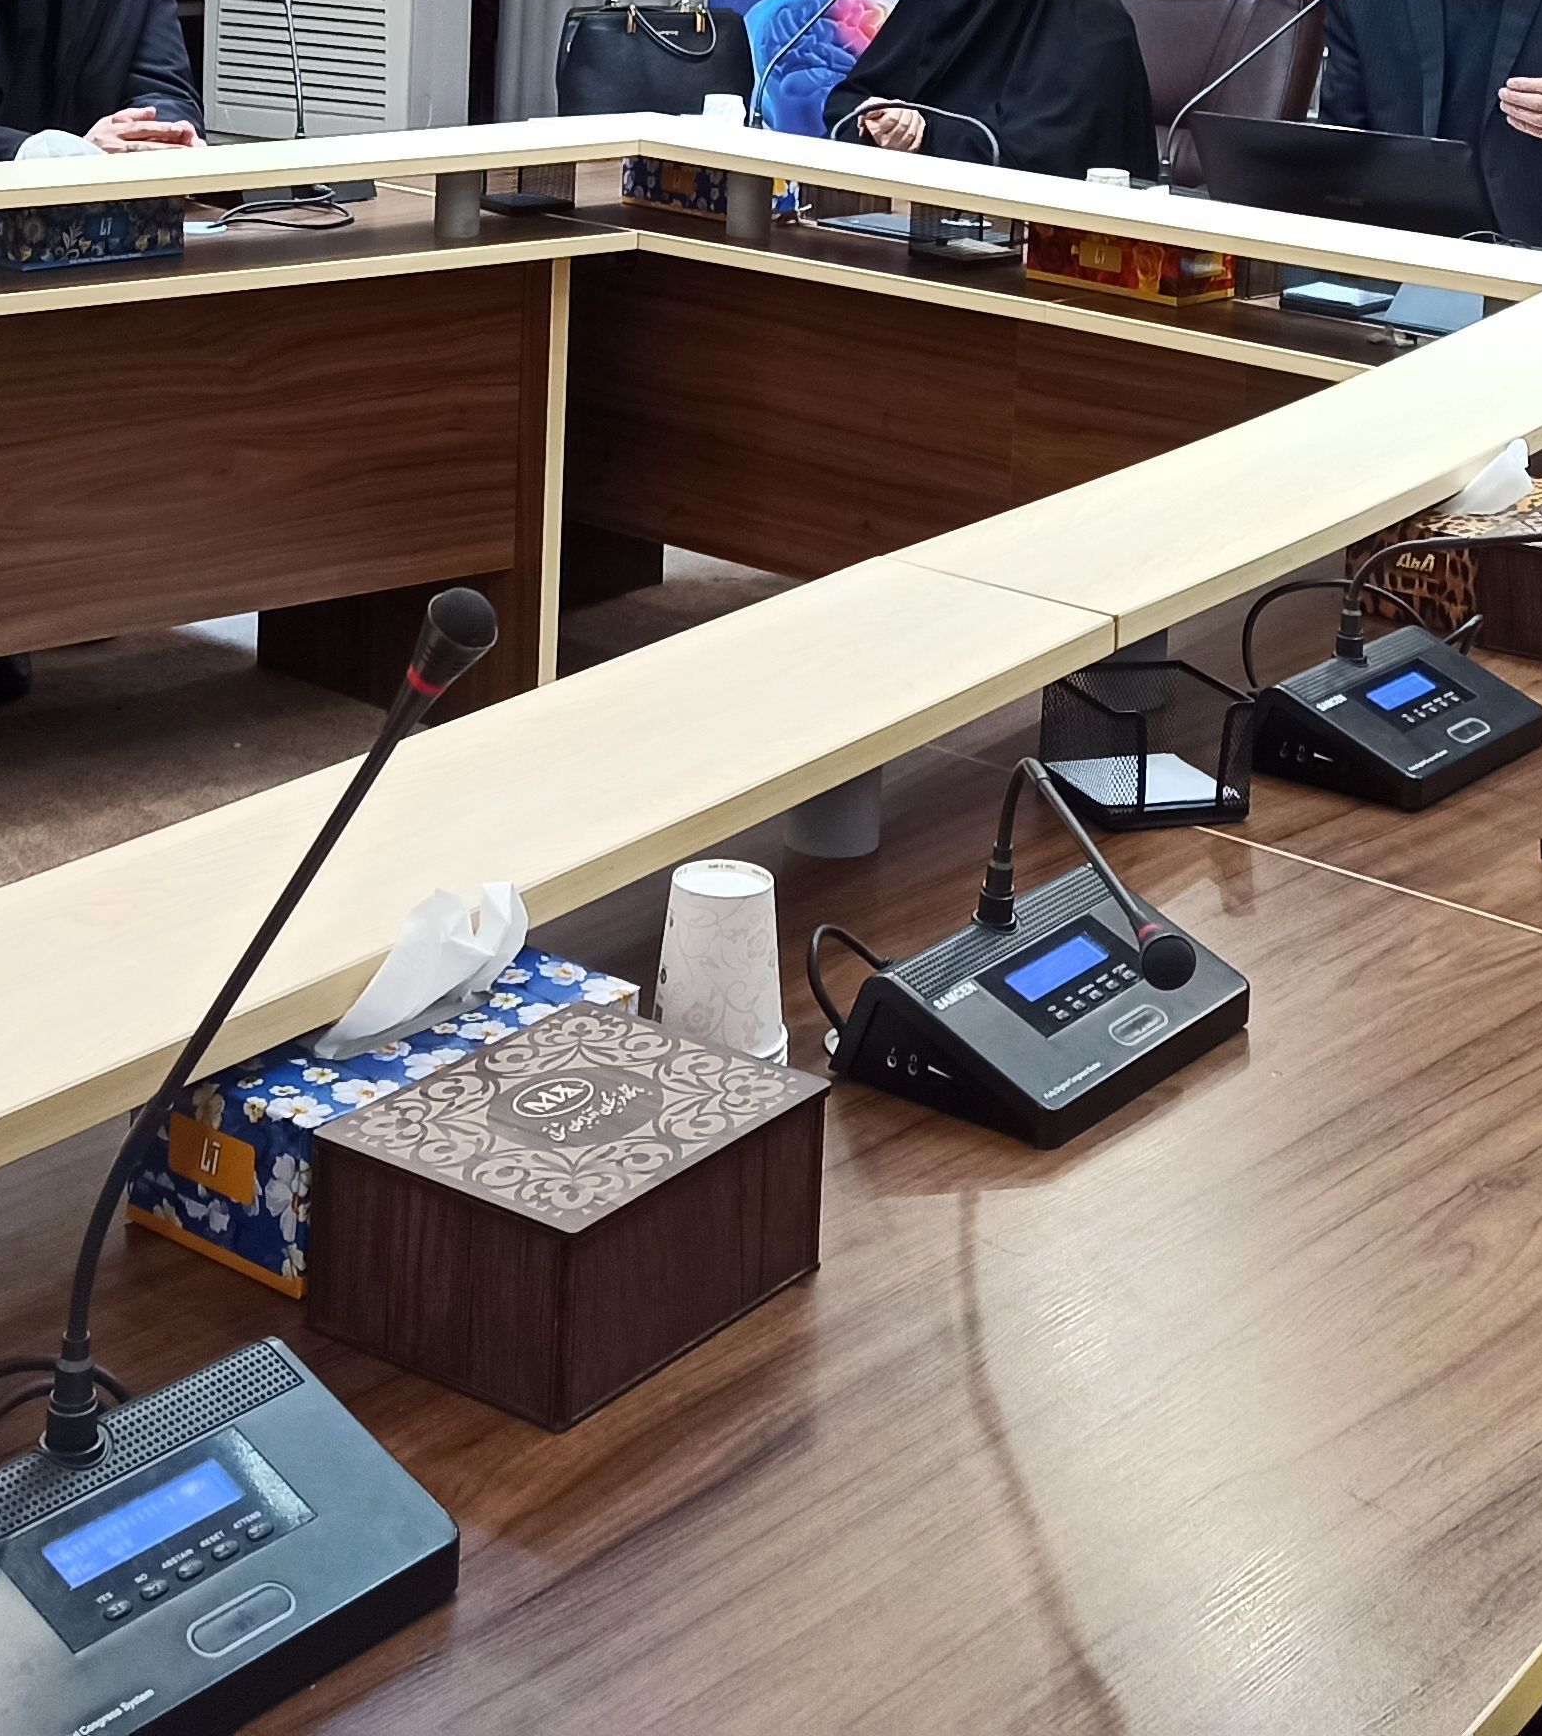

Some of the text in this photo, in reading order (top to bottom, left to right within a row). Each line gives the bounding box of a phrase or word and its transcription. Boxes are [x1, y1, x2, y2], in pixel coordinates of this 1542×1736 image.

[933, 980, 979, 1010] SAMCEN
[95, 1592, 114, 1605] YES
[134, 1573, 148, 1584] NO
[199, 1529, 226, 1548] RESET
